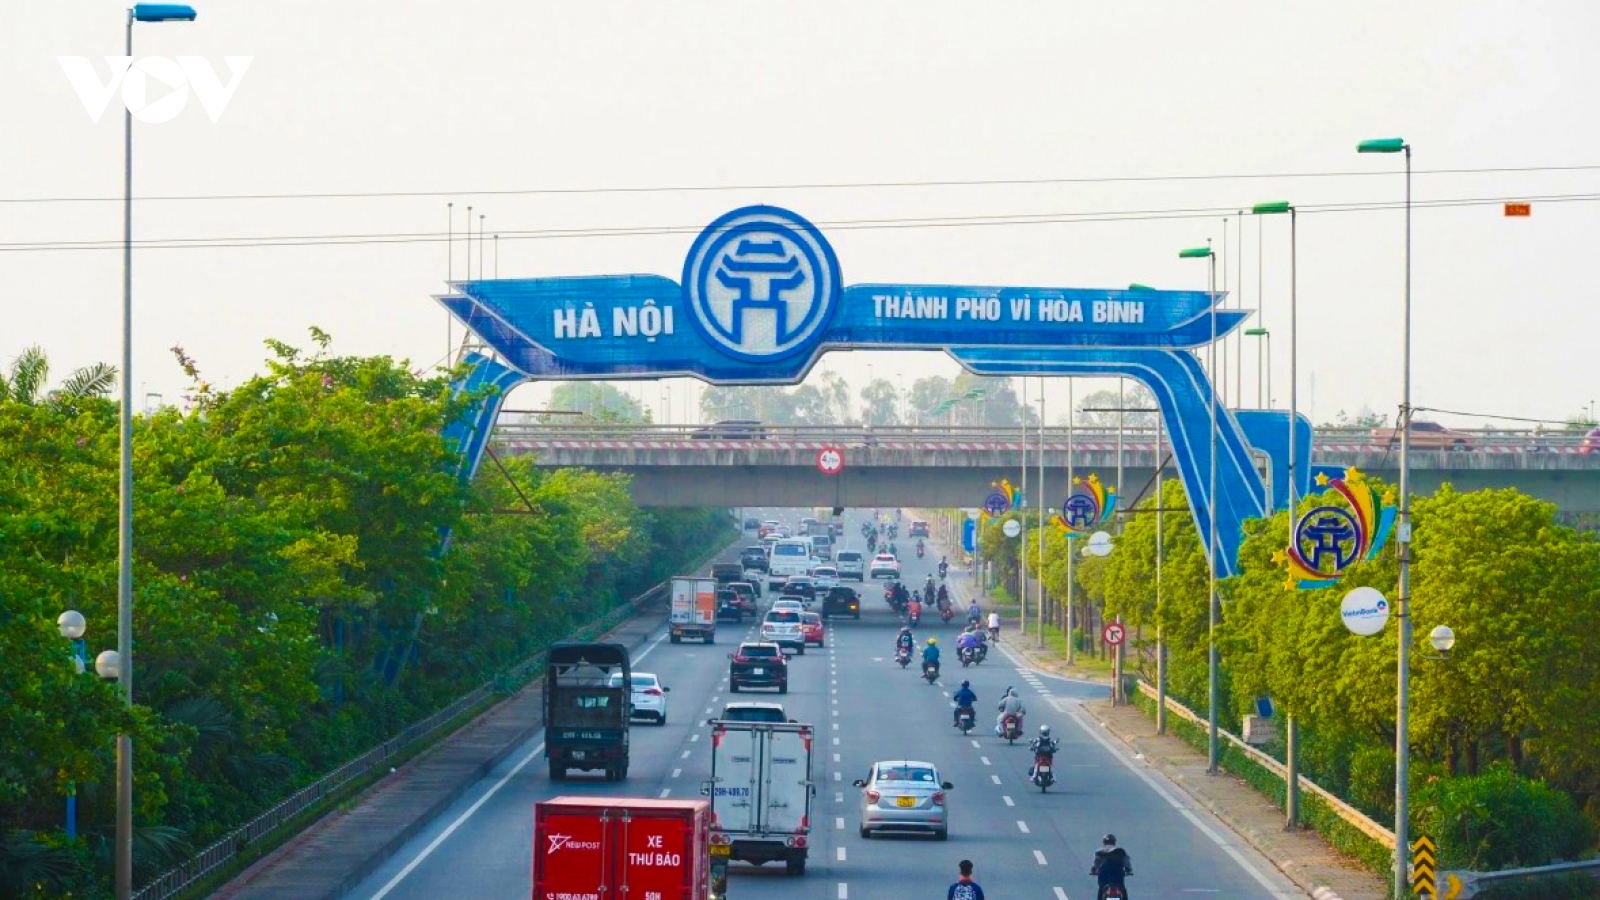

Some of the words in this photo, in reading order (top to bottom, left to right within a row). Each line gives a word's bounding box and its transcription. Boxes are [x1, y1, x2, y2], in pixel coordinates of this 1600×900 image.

[872, 291, 948, 319] THÀNH
[955, 289, 1001, 321] PHỐ
[1010, 294, 1031, 321] VÌ
[1038, 295, 1084, 322] HÒA
[1092, 297, 1145, 323] BÌNH
[553, 301, 602, 339] HÀ
[613, 299, 674, 342] NỘI
[646, 835, 663, 848] XE
[628, 851, 654, 866] THƯ
